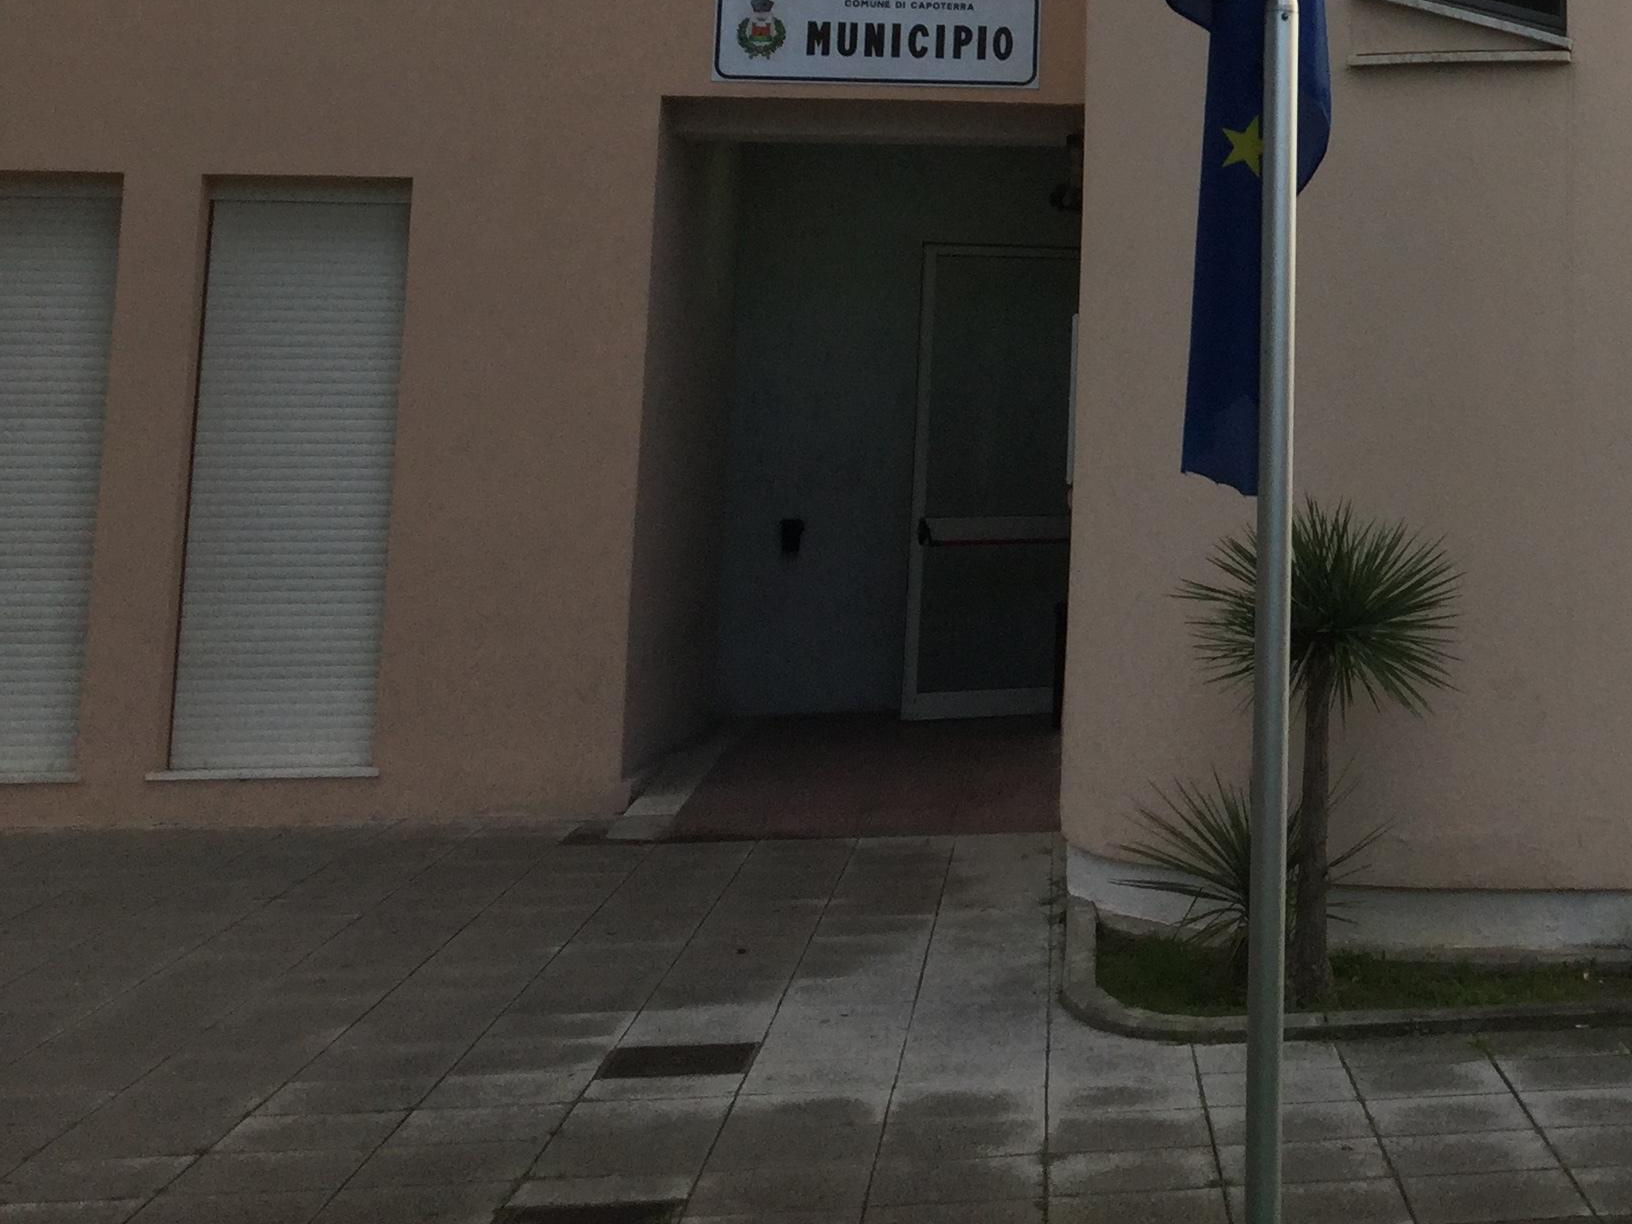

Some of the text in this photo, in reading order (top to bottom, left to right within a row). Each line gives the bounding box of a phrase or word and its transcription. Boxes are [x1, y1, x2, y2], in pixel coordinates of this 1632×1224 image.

[844, 0, 975, 11] COMUNE DI CAPOTERRA
[806, 20, 1014, 61] MUNICIPIO
